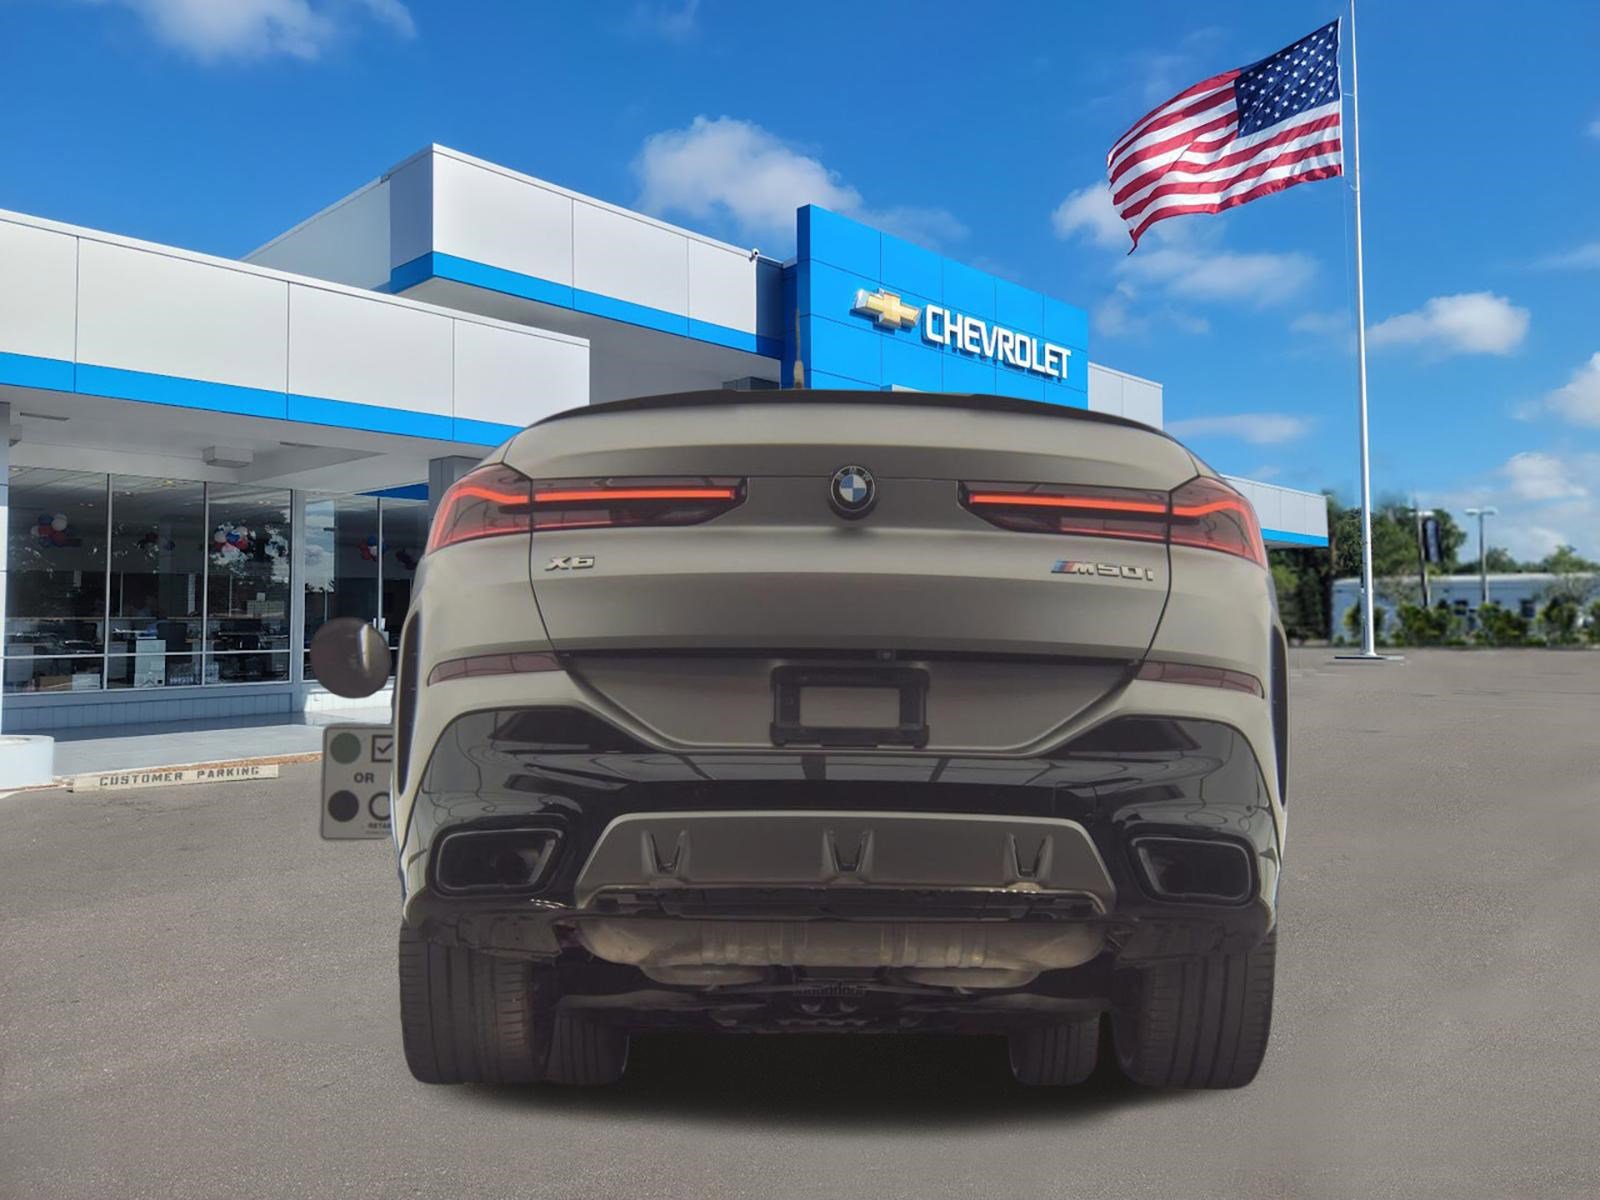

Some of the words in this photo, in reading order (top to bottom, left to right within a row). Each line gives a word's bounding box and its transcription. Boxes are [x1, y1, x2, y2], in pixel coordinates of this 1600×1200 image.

[925, 303, 1072, 380] CHEVROLET
[544, 556, 595, 572] X6
[1070, 560, 1154, 582] M50i
[99, 771, 184, 787] CUSTOMER
[196, 765, 260, 780] PARKING
[353, 772, 375, 784] OR
